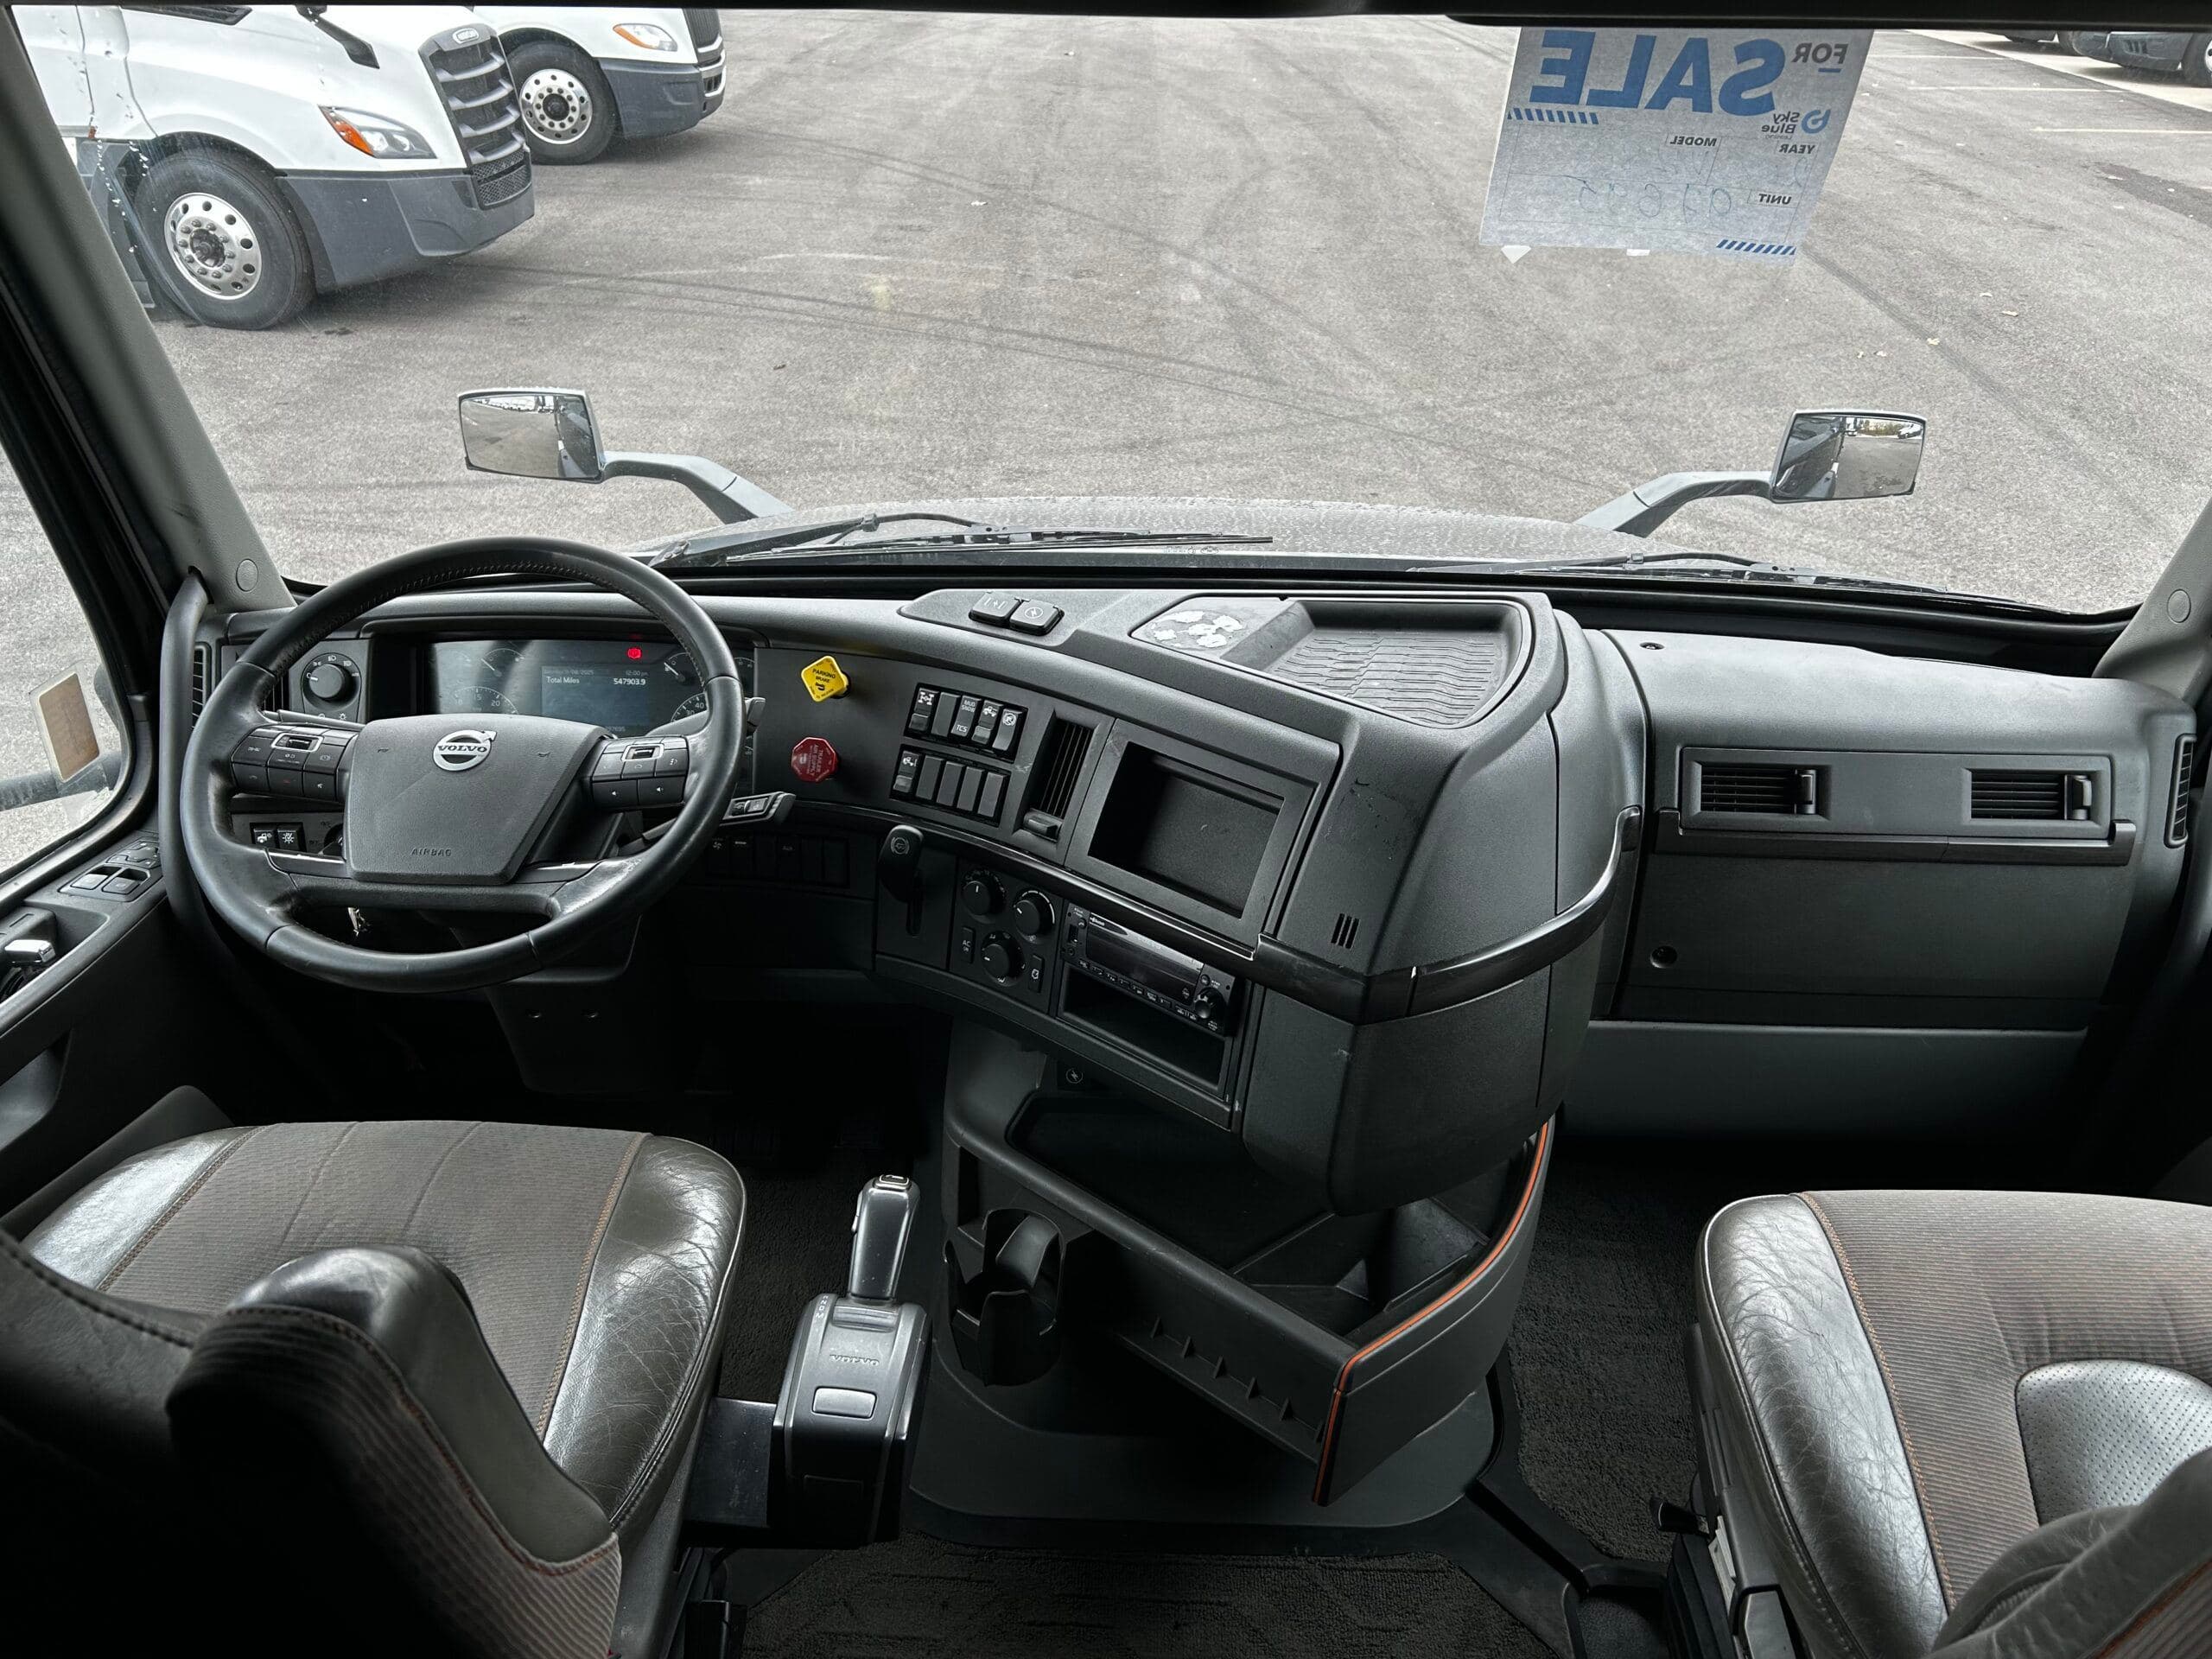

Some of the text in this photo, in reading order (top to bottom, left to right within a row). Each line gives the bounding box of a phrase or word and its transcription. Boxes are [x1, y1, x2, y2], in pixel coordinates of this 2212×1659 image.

[812, 668, 836, 679] PARKING
[957, 724, 968, 733] TCS
[410, 847, 452, 857] AIRBAG
[962, 939, 972, 948] AC
[830, 1353, 880, 1367] VOLVO
